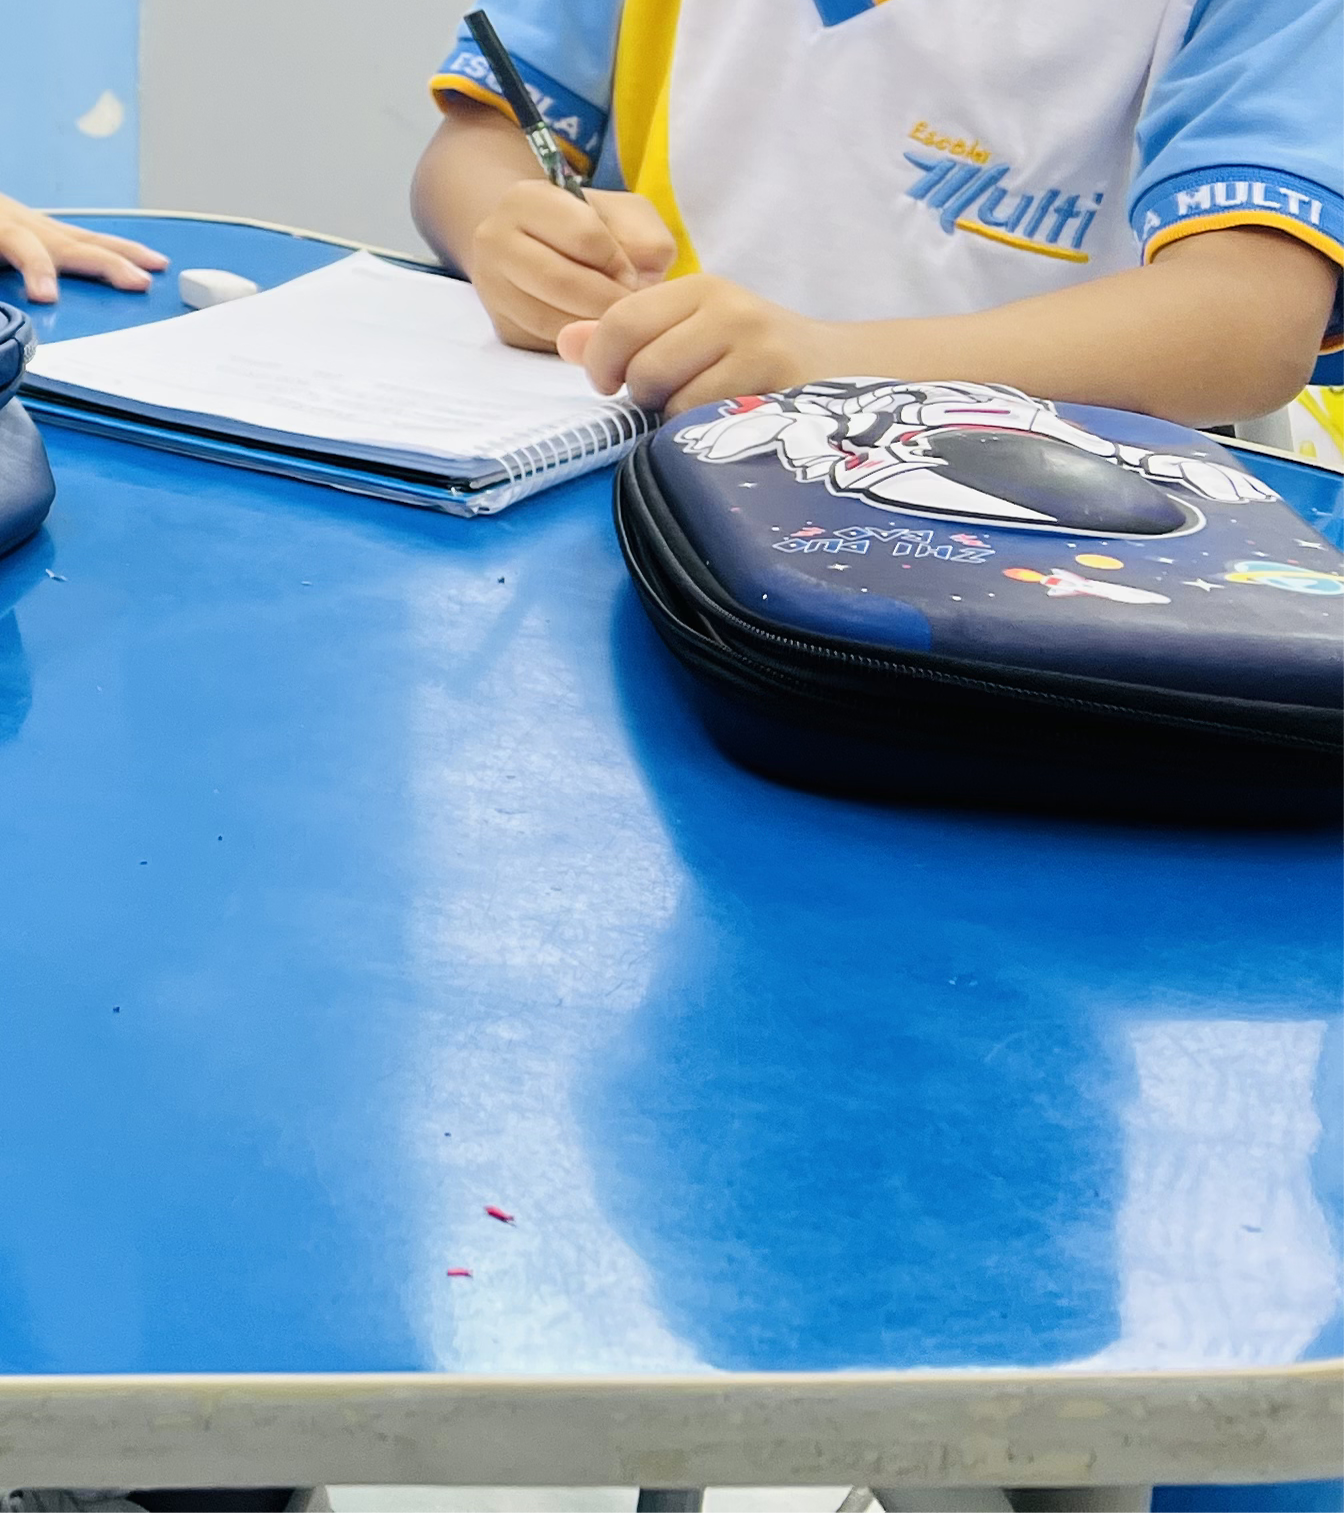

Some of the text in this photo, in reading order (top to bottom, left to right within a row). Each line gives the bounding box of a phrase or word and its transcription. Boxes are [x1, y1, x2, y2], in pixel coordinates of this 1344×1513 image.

[908, 120, 992, 165] Escola
[902, 152, 1105, 251] Multi
[1175, 180, 1323, 226] MULTI
